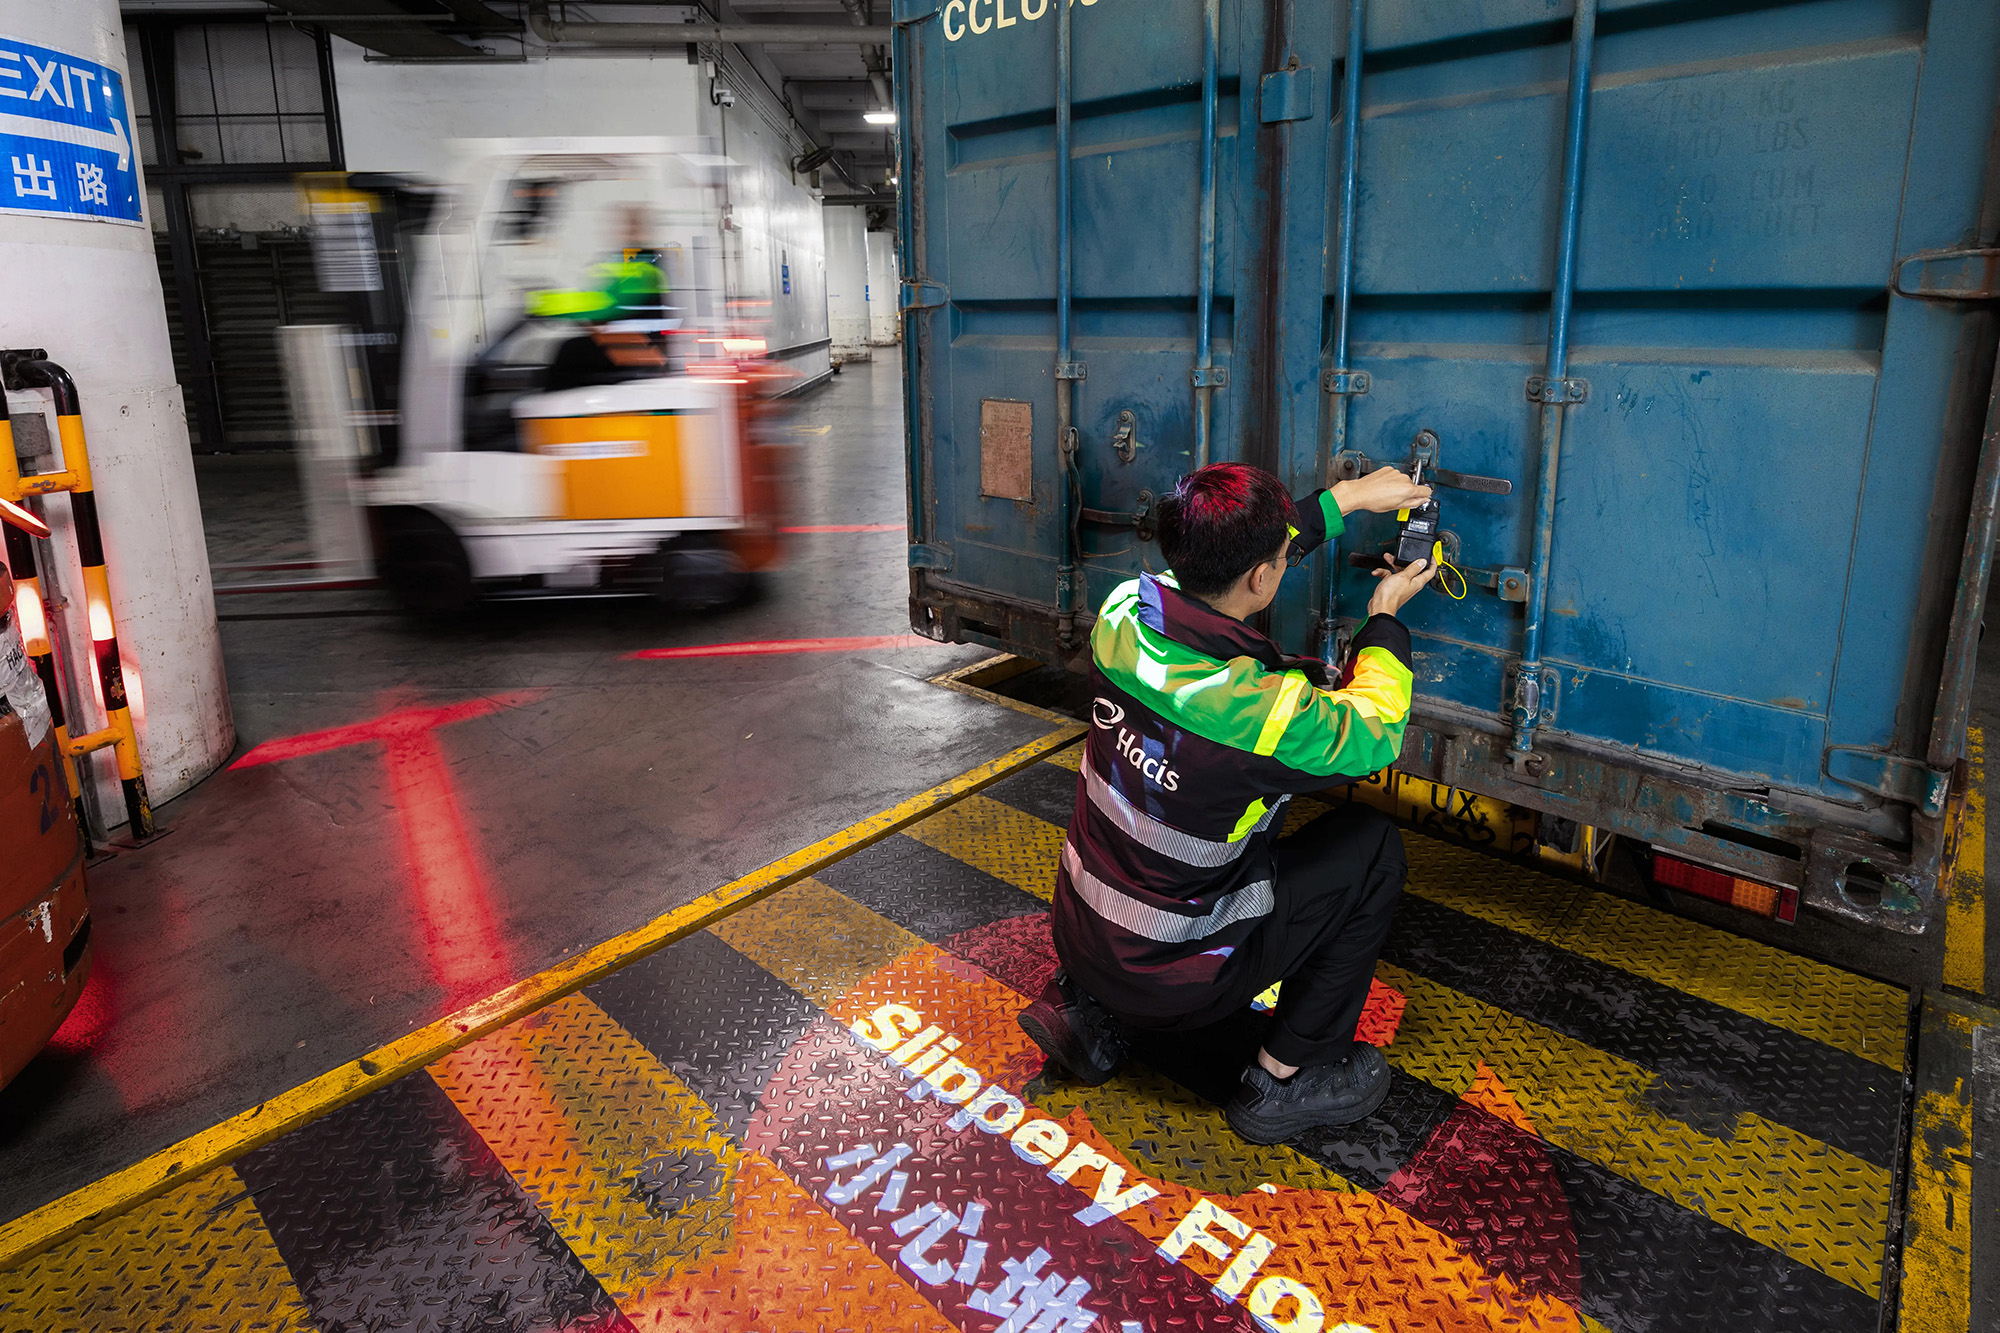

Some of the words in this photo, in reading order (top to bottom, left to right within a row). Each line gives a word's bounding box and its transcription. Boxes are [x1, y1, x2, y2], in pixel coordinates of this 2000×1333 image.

[0, 51, 95, 113] EXIT
[11, 153, 108, 206] 出路
[1116, 727, 1180, 792] Hacis
[849, 1003, 1160, 1227] Slippery
[1155, 1197, 1378, 1333] Flo
[823, 1143, 1145, 1333] 小心地
